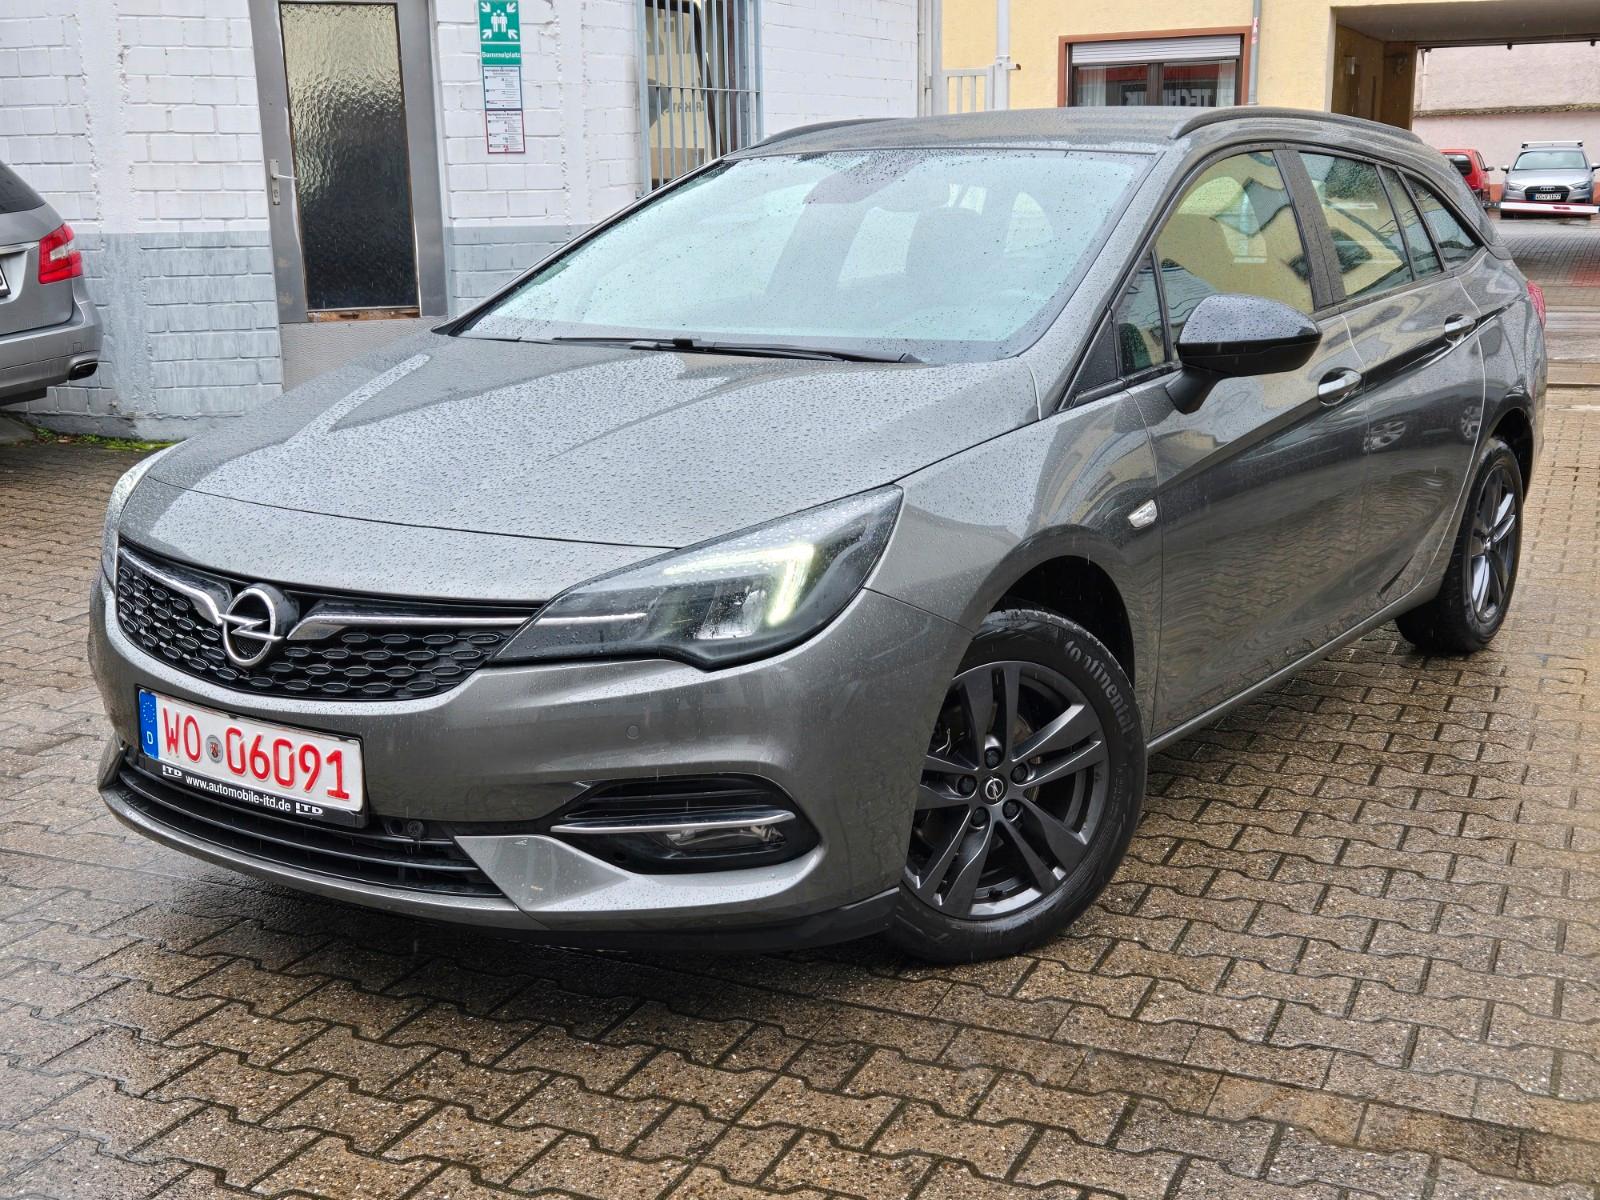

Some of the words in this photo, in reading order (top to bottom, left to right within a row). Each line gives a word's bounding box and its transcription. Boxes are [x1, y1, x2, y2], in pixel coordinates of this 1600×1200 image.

[1064, 640, 1136, 735] Continental
[146, 730, 154, 745] D
[163, 707, 202, 763] WO
[225, 727, 351, 801] 06091
[185, 774, 291, 812] www.automobile-itd.de
